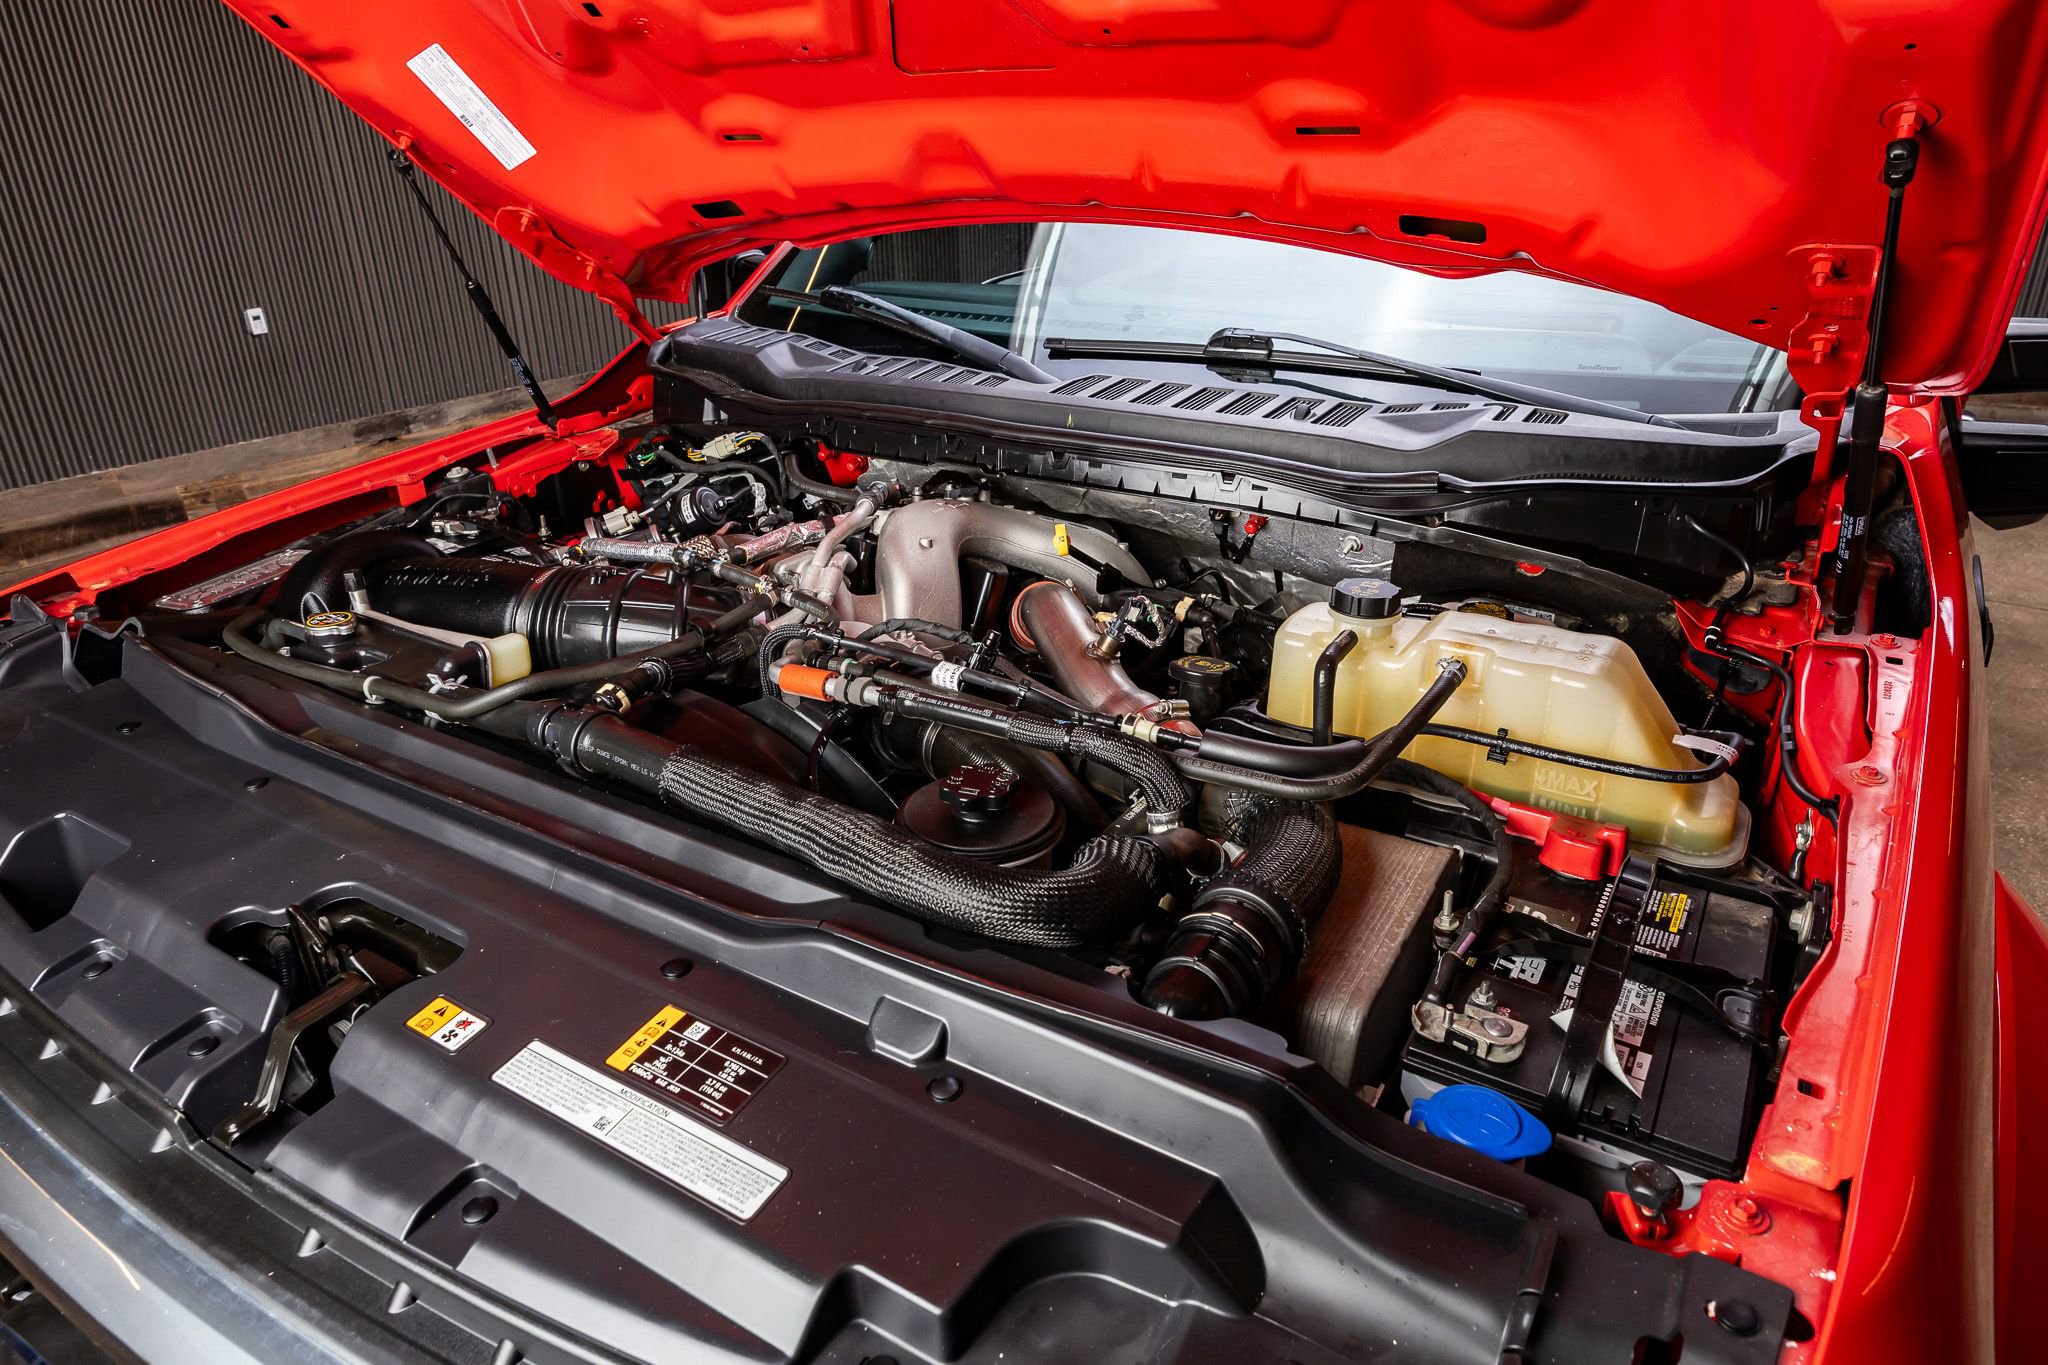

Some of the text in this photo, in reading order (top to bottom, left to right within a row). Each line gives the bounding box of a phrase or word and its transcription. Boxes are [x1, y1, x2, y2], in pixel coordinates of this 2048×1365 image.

[1546, 770, 1599, 798] MAX
[1652, 990, 1667, 1026] GER/POISON
[627, 1064, 654, 1081] FoMoCo
[651, 1058, 667, 1070] PAG
[618, 1087, 671, 1118] MODIFICATION
